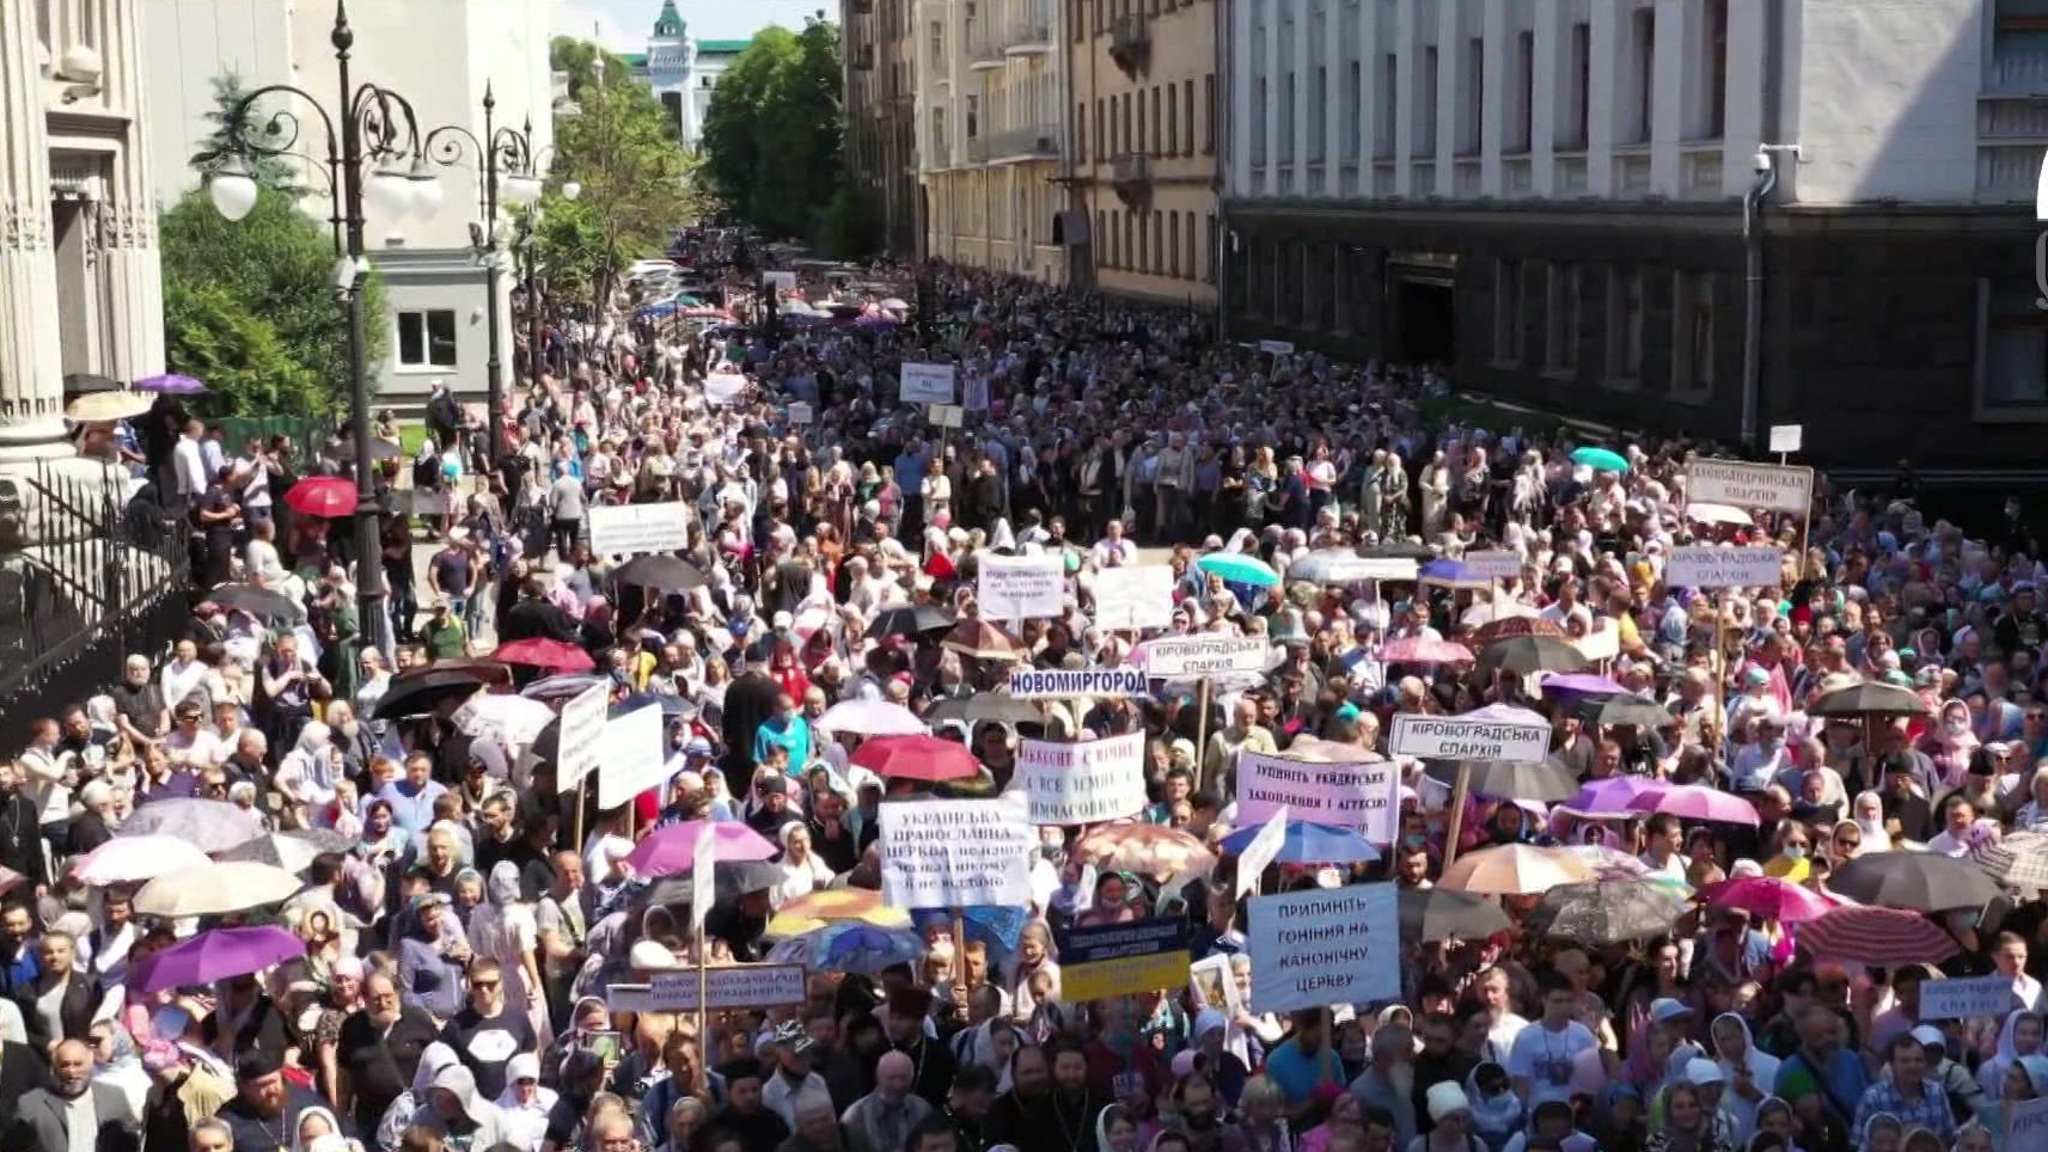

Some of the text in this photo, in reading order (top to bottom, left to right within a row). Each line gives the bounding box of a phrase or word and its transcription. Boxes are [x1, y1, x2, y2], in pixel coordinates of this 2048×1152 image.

[1156, 641, 1260, 657] КІРОВОГРАДСЬКА
[1183, 658, 1233, 673] ЄПАРХІЯ
[1011, 671, 1147, 693] НОВОМИРГОРОД
[1412, 723, 1540, 742] КІРОВОГРАДСЬКА
[1439, 742, 1501, 756] ЄПАРХІЯ
[1256, 764, 1385, 786] ЗУПИНІТЬ РЕЙДЕРСЬКЕ
[1249, 789, 1387, 810] ЗАХОПЛЕННЯ І АГРЕСІЮ
[902, 811, 1001, 826] УКРАЇНСЬКА
[894, 828, 1011, 842] ПРАВОСЛАВНА
[887, 847, 948, 859] ЦЕРКВА
[1278, 898, 1366, 918] ПРИПИНІТЬ
[1278, 922, 1369, 945] ГОНІННЯ НА
[1280, 947, 1369, 969] КАНОНІЧНУ
[1296, 974, 1354, 993] ЦЕРКВУ
